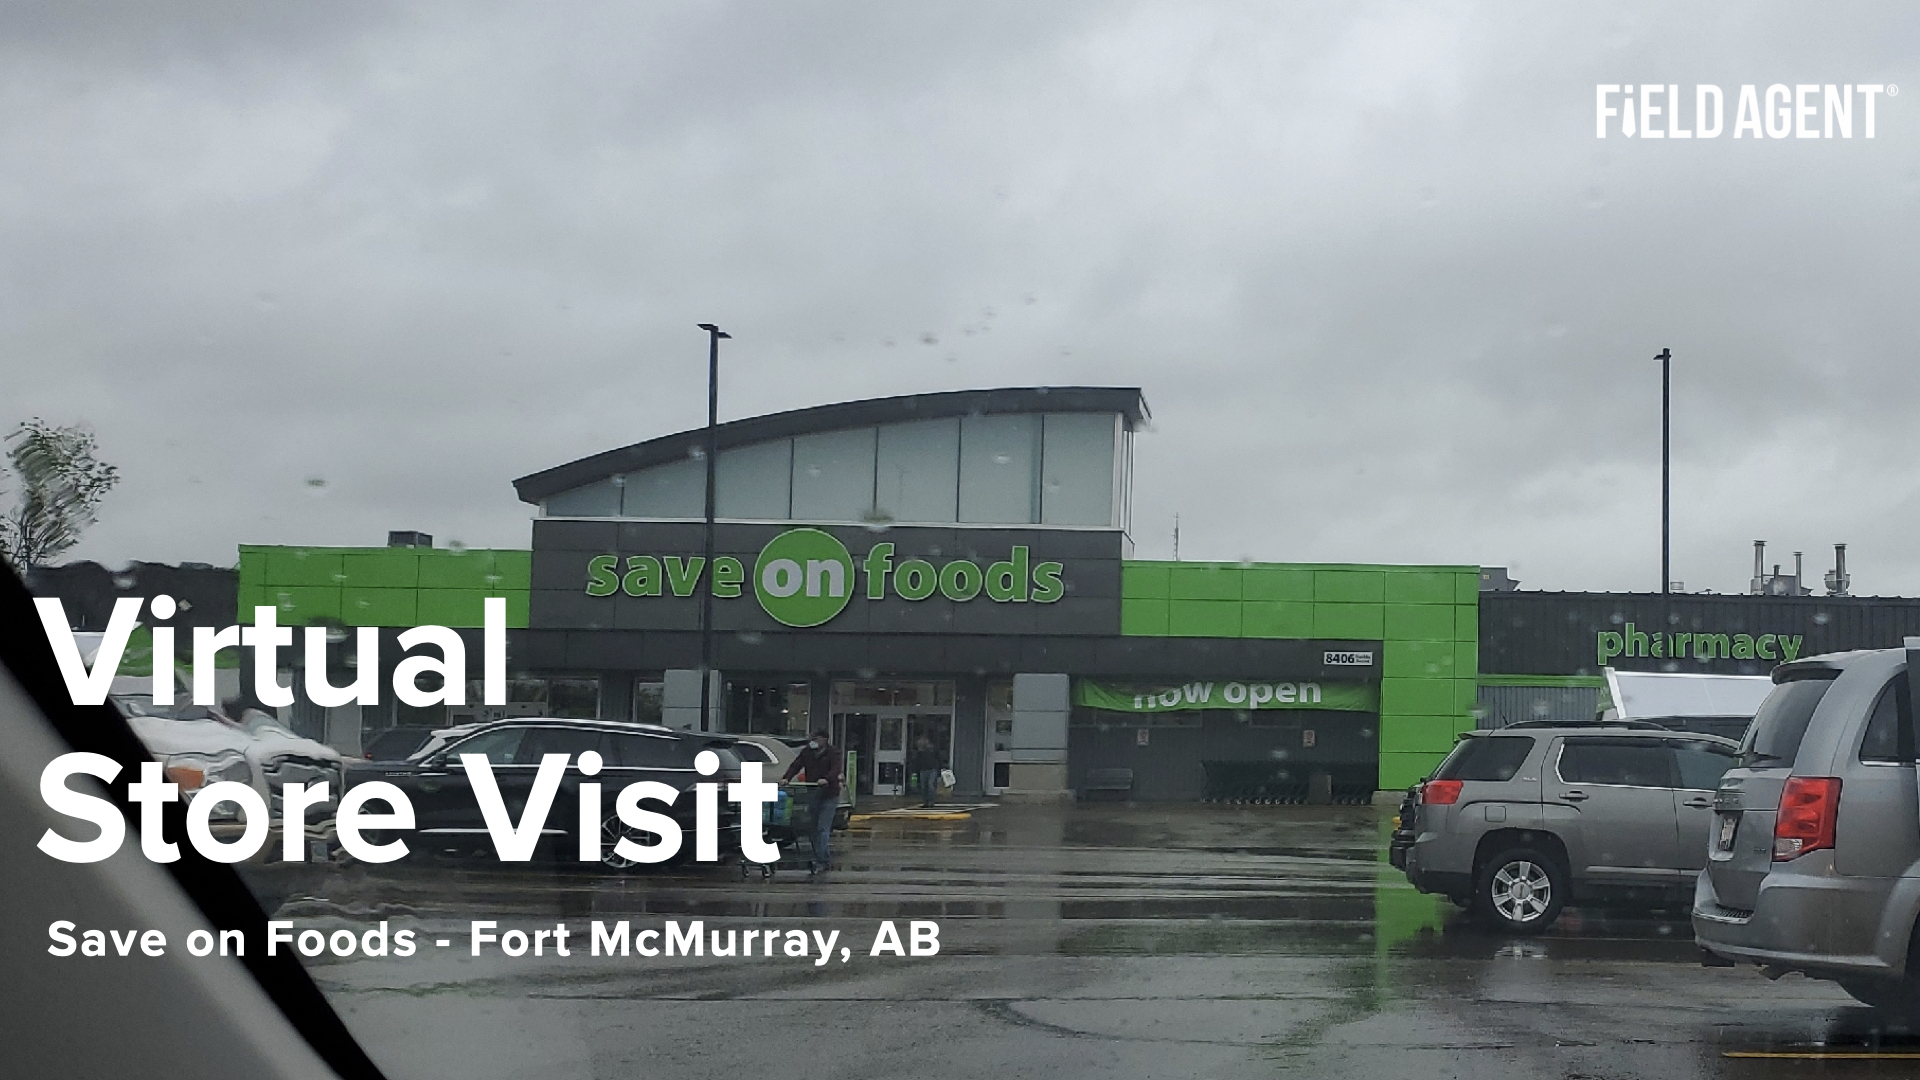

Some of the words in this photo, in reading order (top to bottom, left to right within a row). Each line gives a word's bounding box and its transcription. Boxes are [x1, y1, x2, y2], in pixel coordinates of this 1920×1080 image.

[585, 554, 745, 598] save
[762, 558, 845, 598] on
[863, 543, 1065, 603] foods
[1326, 653, 1355, 664] 8406
[1597, 622, 1803, 666] pharmacy
[1223, 681, 1322, 710] open
